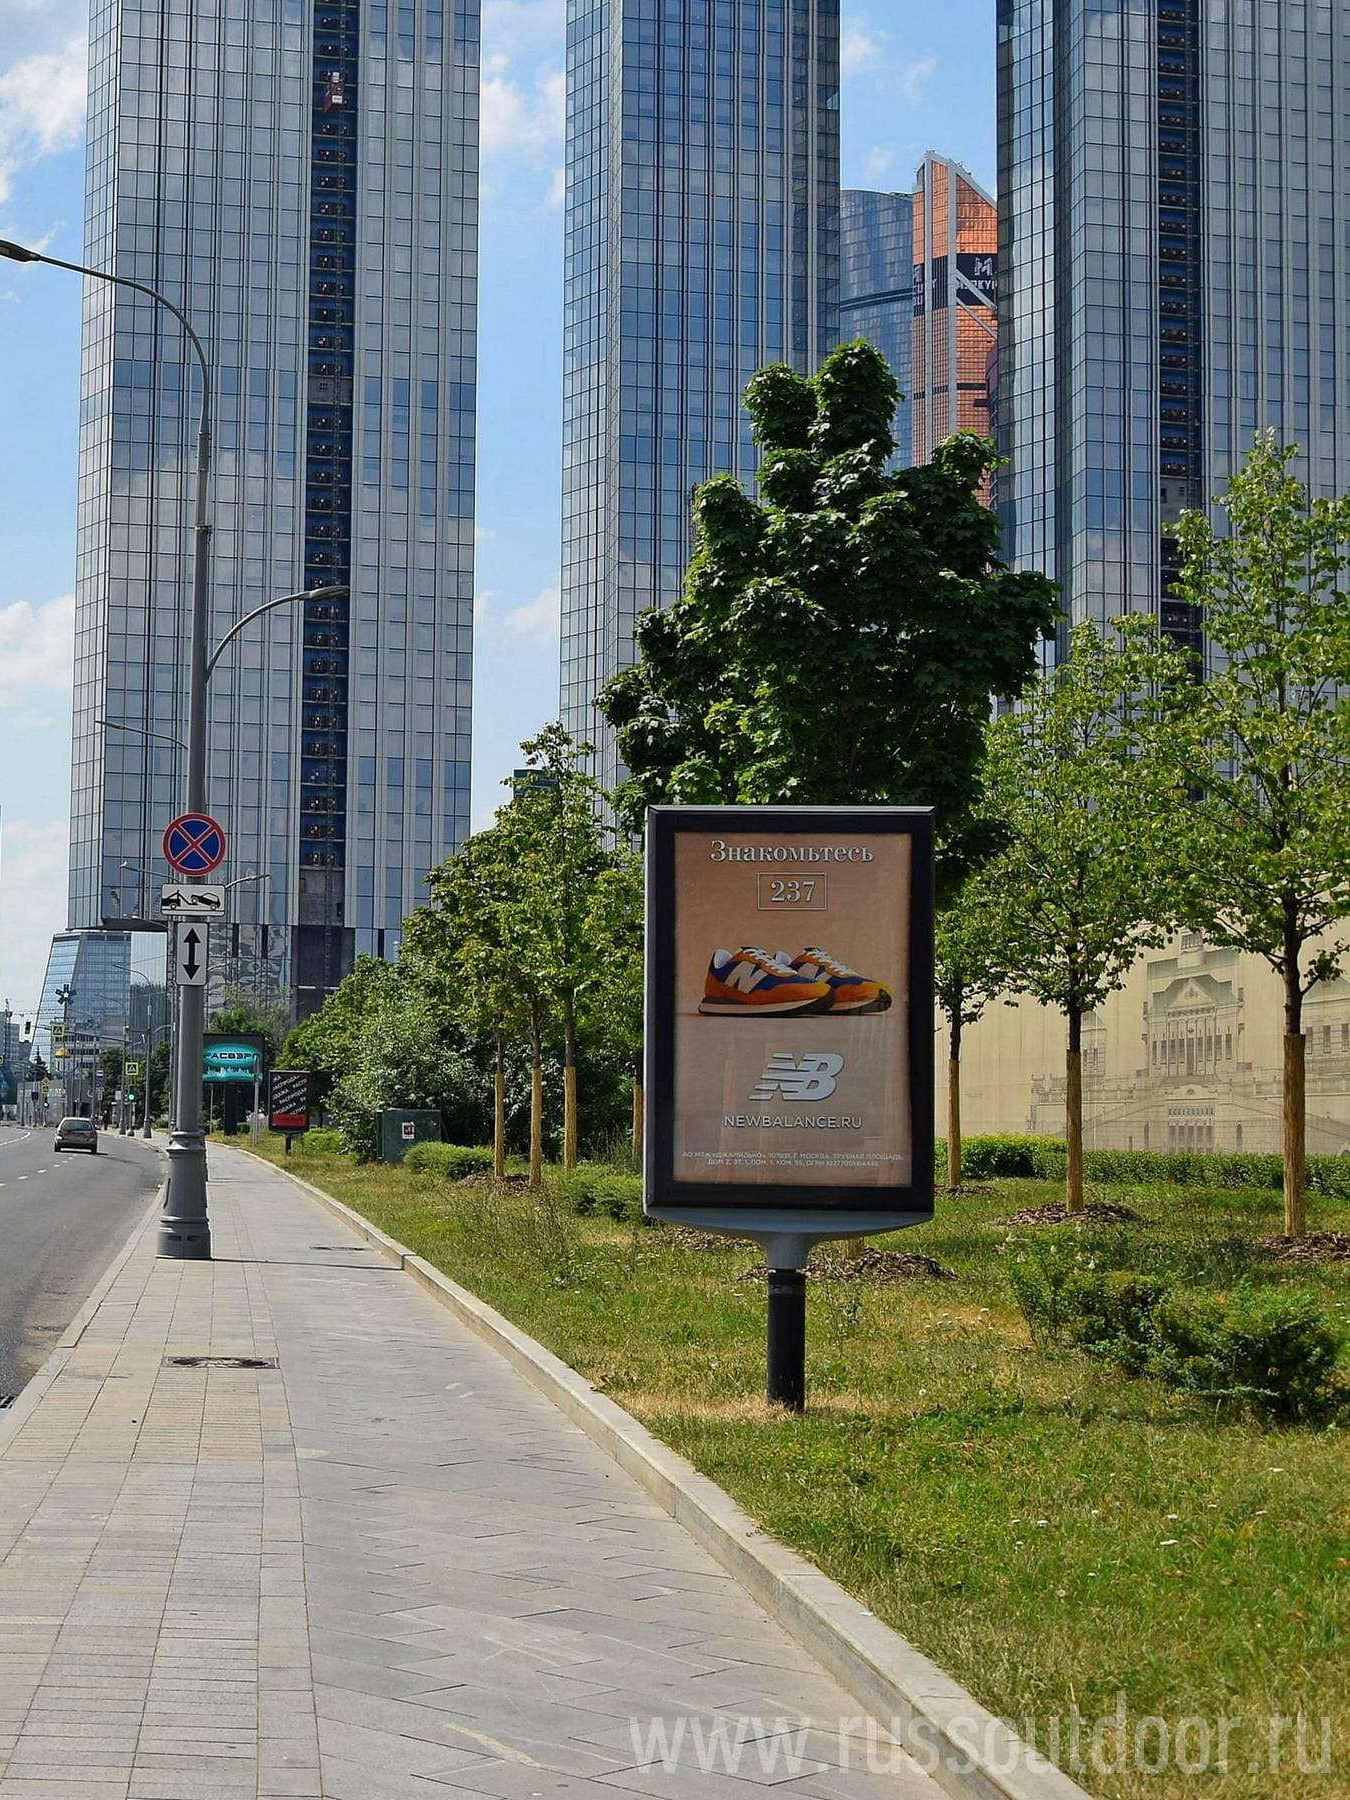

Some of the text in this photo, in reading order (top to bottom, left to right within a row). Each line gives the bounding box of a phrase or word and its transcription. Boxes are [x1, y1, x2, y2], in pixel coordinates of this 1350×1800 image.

[710, 840, 874, 863] Знакомьтесь
[770, 880, 816, 903] 237
[723, 1115, 863, 1129] NEWBALANCE.RU
